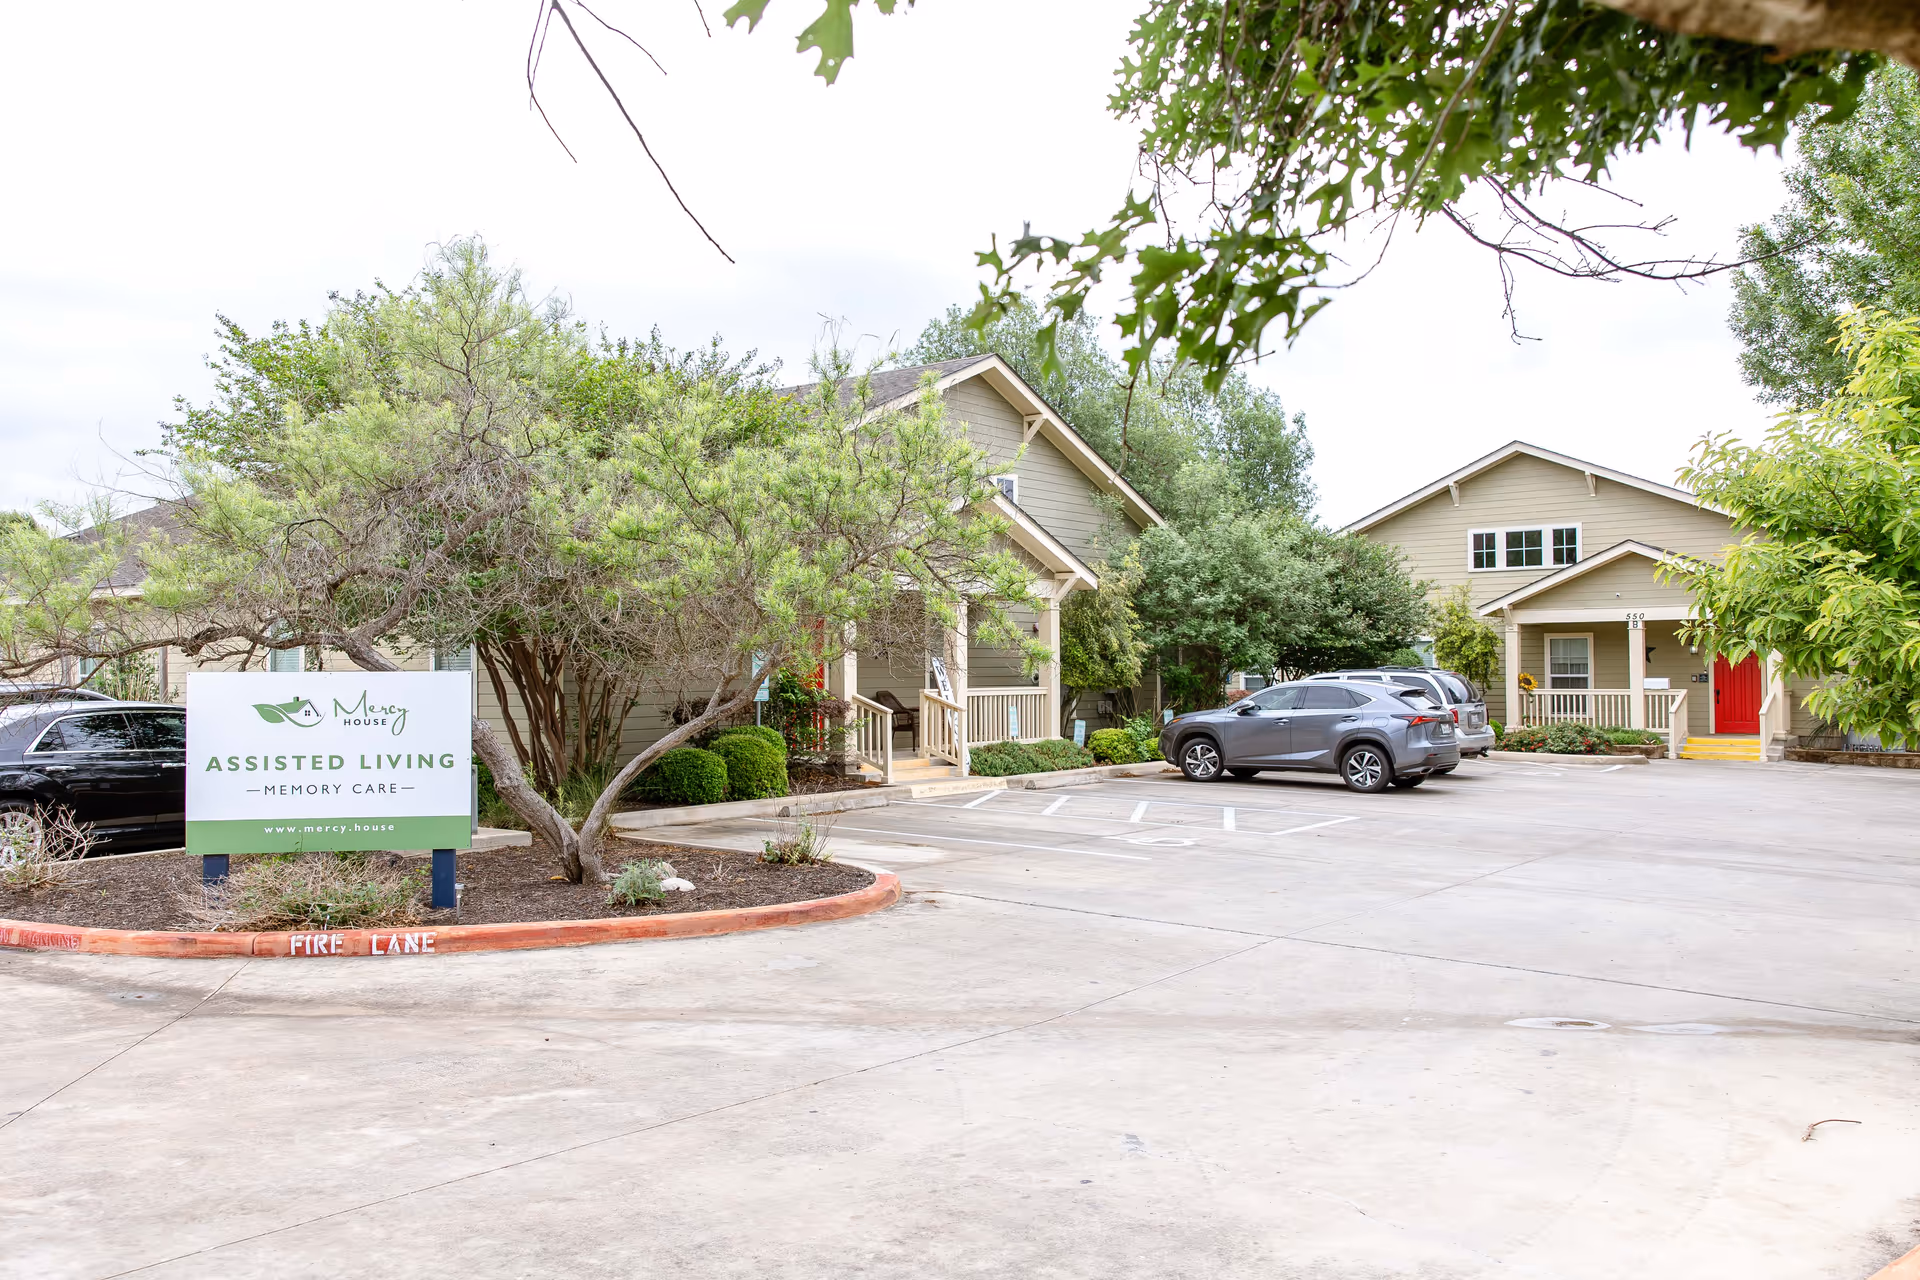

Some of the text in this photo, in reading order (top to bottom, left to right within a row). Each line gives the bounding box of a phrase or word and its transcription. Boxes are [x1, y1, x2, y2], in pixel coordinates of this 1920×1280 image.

[1625, 612, 1645, 620] 550
[333, 690, 409, 736] Mercy
[343, 718, 387, 726] HOUSE
[205, 753, 455, 772] ASSISTED LIVING
[264, 823, 395, 834] www.mercy.house
[290, 932, 438, 955] FIRE LANE
